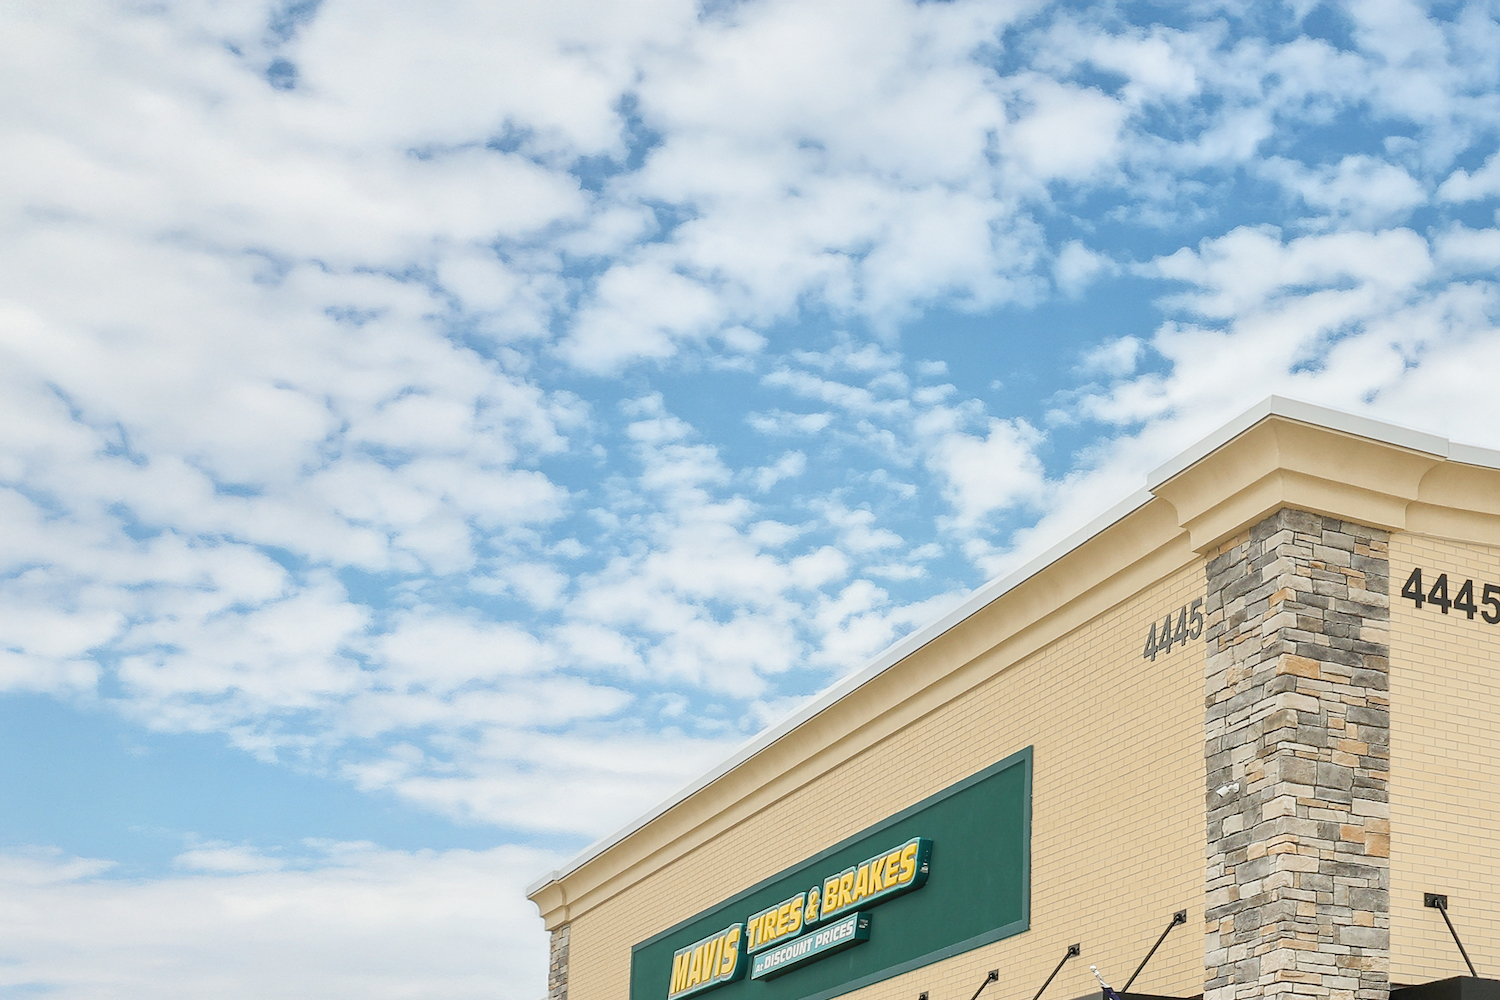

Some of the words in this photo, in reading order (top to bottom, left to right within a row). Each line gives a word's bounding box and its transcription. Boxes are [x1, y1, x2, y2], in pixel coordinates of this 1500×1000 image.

[1143, 597, 1203, 662] 4445
[671, 927, 740, 995] MAVIS
[748, 895, 804, 949] TIRES
[804, 889, 821, 922] &
[822, 842, 919, 914] BRAKES
[764, 938, 814, 968] DISCOUNT
[815, 919, 854, 948] PRICES
